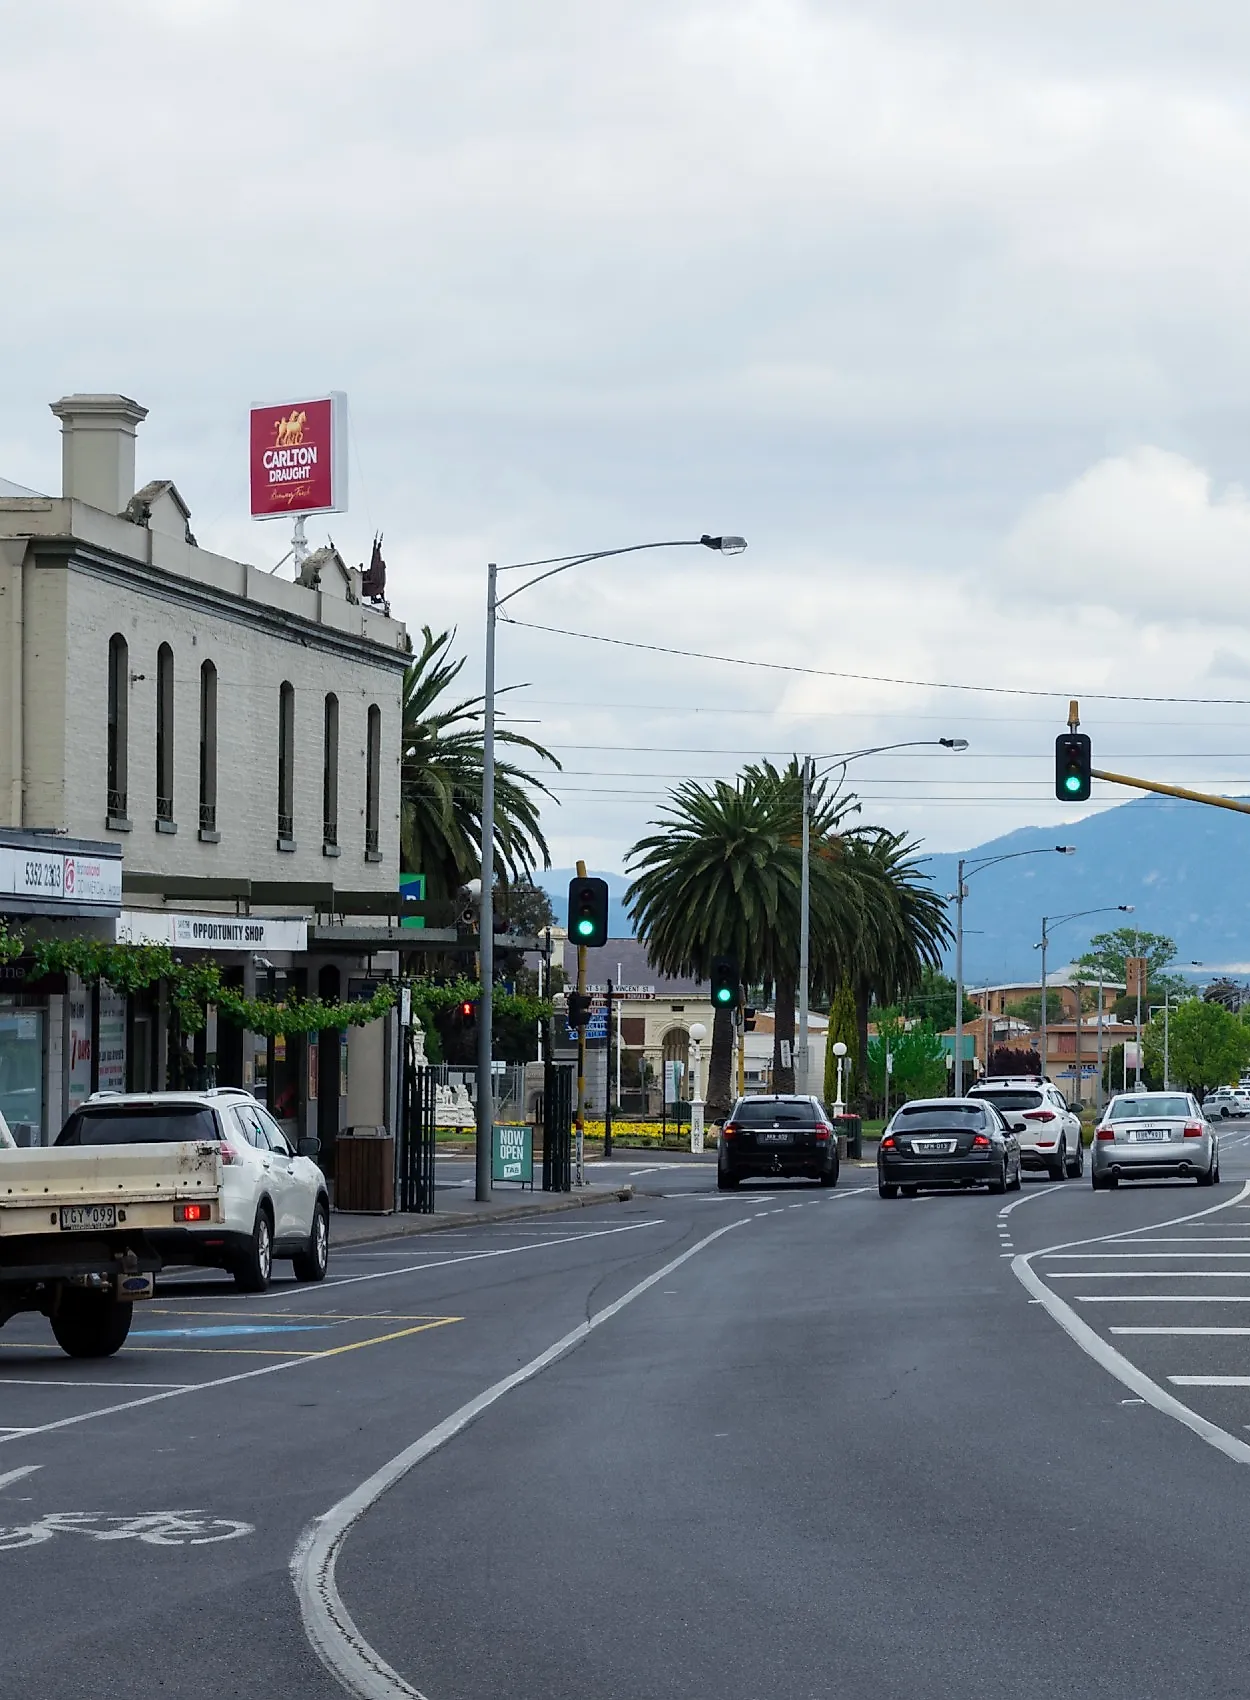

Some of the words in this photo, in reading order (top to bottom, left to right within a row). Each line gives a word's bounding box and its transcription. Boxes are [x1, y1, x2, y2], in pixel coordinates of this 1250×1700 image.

[263, 447, 317, 469] CARLTON
[269, 466, 311, 483] DRAUGHT
[25, 861, 42, 886] 5352
[193, 922, 243, 941] OPPORTUNITY
[244, 925, 264, 942] SHOP
[500, 1129, 524, 1146] NOW
[500, 1145, 524, 1160] OPEN
[505, 1166, 520, 1174] TAB
[63, 1208, 84, 1224] YGY
[93, 1208, 113, 1222] 099
